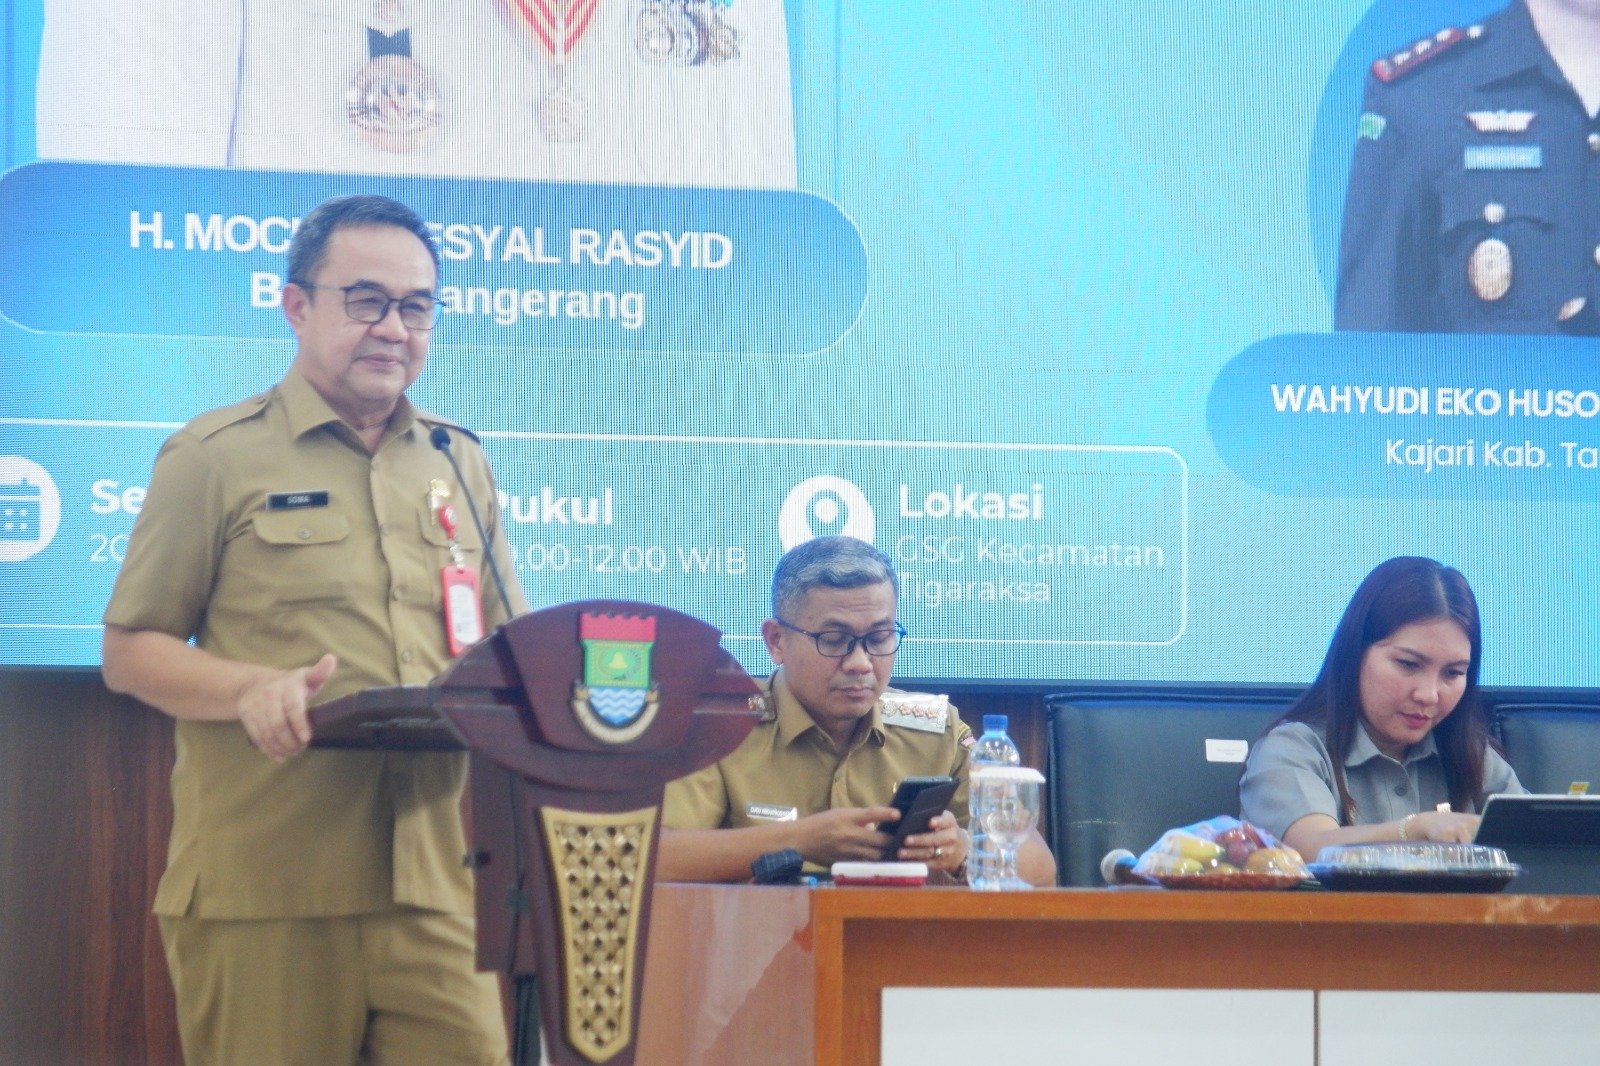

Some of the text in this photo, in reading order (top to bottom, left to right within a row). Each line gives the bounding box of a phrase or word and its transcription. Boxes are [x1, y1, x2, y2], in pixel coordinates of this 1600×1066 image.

[130, 210, 174, 249] H.
[184, 211, 301, 254] MOC
[571, 228, 734, 270] RASYID
[441, 285, 645, 330] angerang
[1271, 383, 1600, 418] WAHYUDI EKO HUSO
[1386, 438, 1475, 474] Kajari
[1484, 440, 1552, 468] Kab.
[899, 483, 1045, 520] Lokasi
[677, 549, 748, 574] WIB
[976, 537, 1165, 568] Kecamatan
[898, 571, 1051, 609] Tigaraksa
